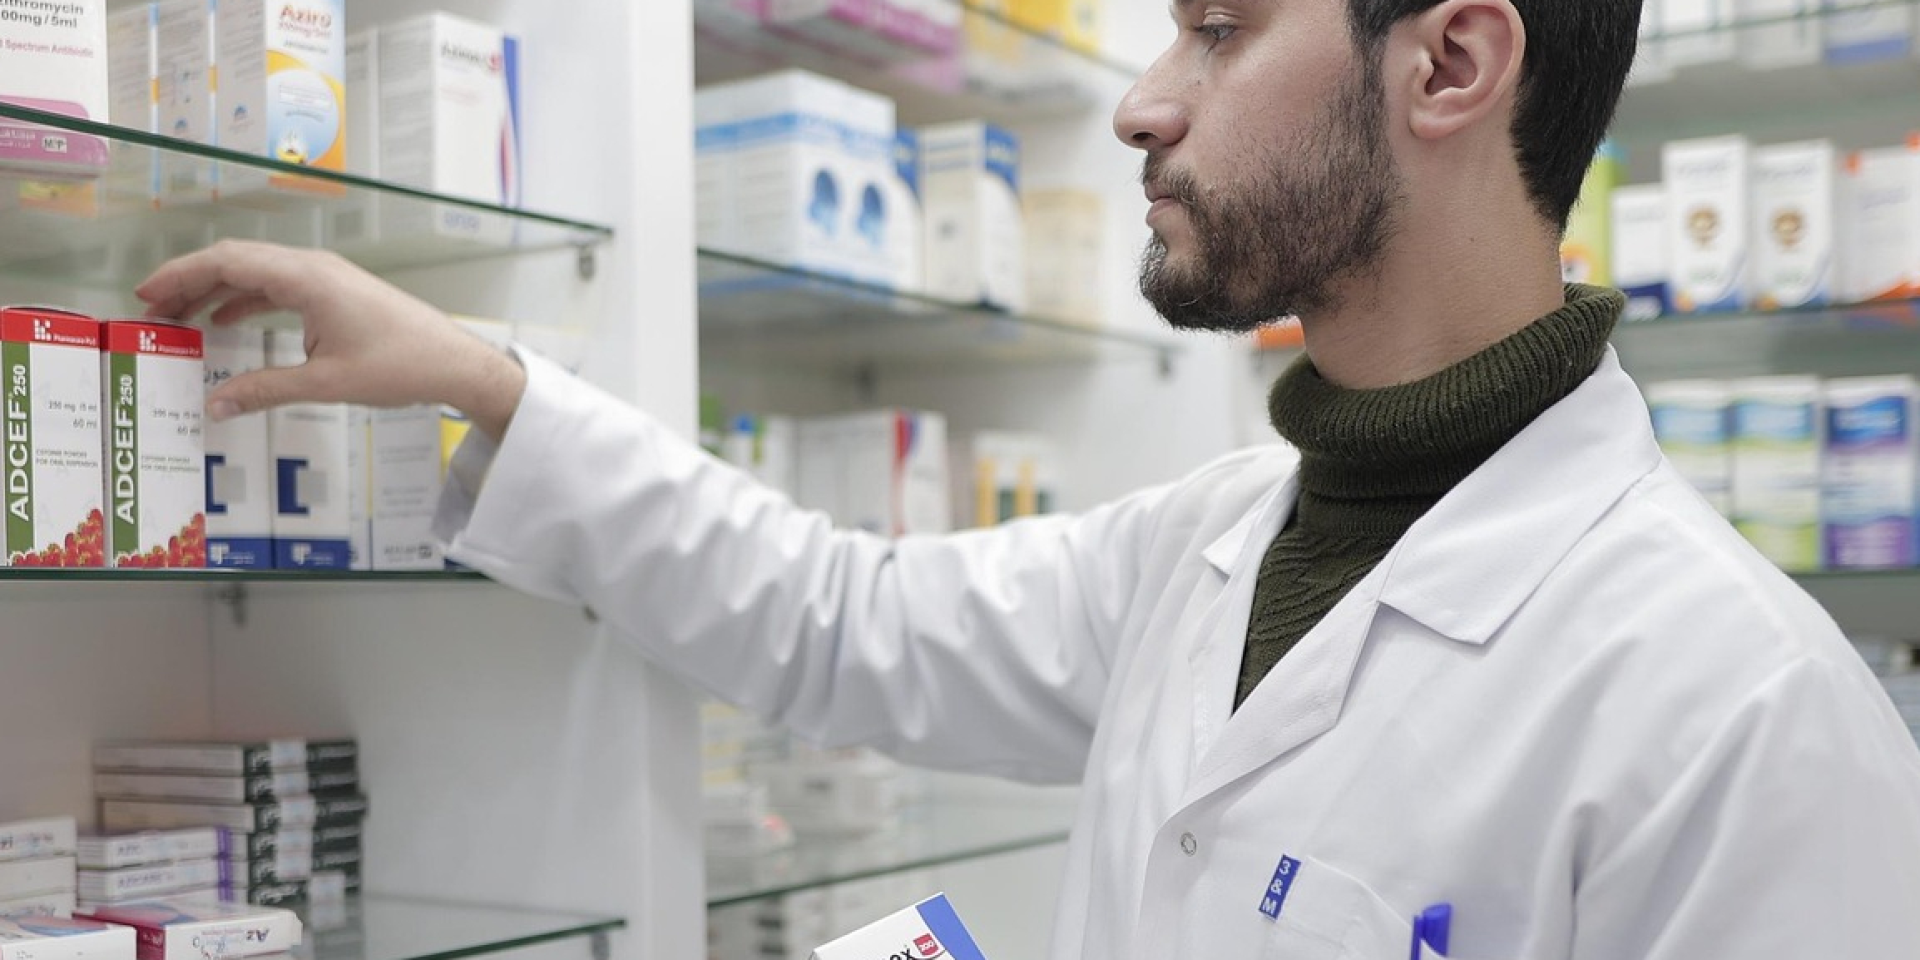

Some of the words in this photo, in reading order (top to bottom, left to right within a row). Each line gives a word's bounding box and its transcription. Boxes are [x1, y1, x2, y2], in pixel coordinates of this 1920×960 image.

[13, 365, 26, 397] 250
[120, 374, 133, 407] 250
[8, 398, 30, 522] ADCEF
[115, 406, 134, 525] ADCEF
